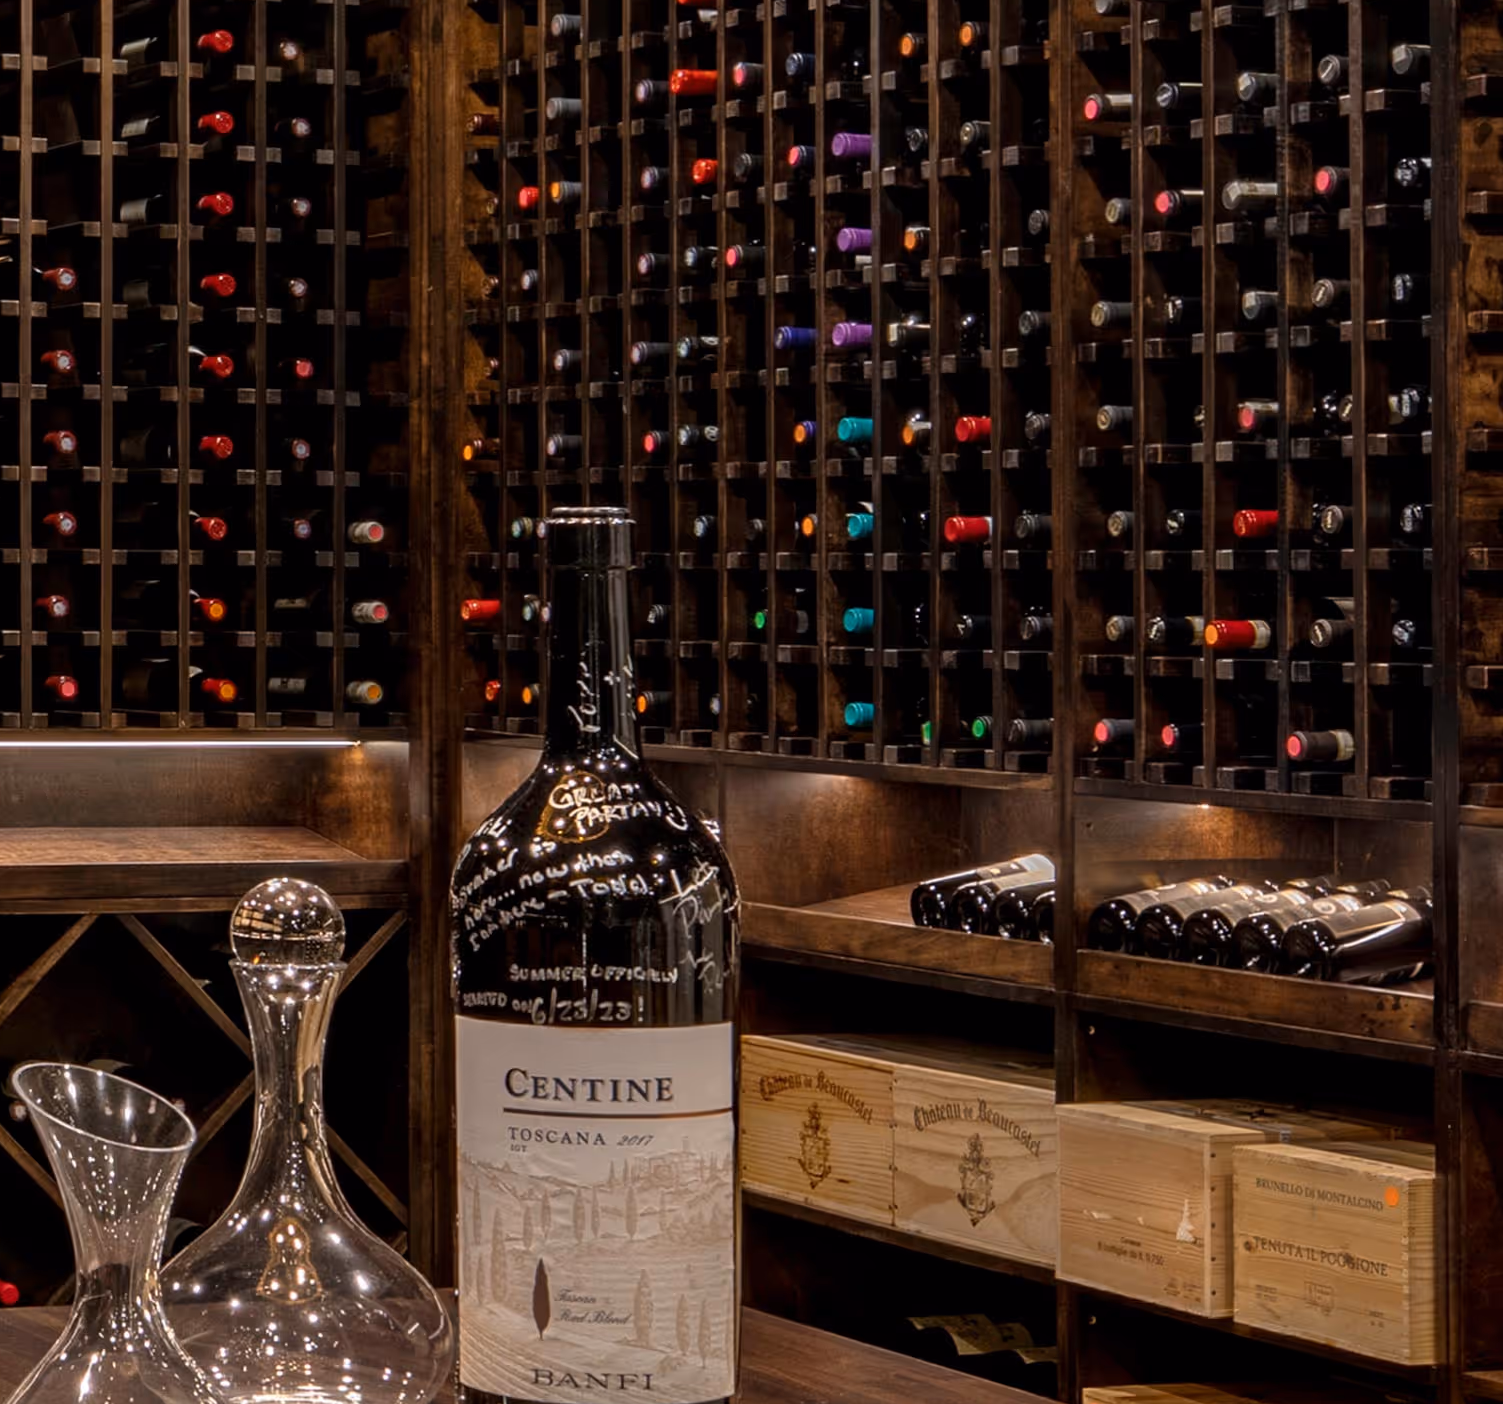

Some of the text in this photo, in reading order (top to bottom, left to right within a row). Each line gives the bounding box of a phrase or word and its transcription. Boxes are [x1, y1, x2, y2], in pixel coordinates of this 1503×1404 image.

[549, 783, 640, 808] GREAT
[504, 1068, 673, 1102] CENTINE
[507, 1127, 606, 1146] TOSCANA
[1255, 1177, 1384, 1212] BRUNELLO DI MONTALCINO
[1253, 1236, 1304, 1259] TENUTA
[1306, 1248, 1318, 1261] IL
[530, 1368, 654, 1390] BANFI
